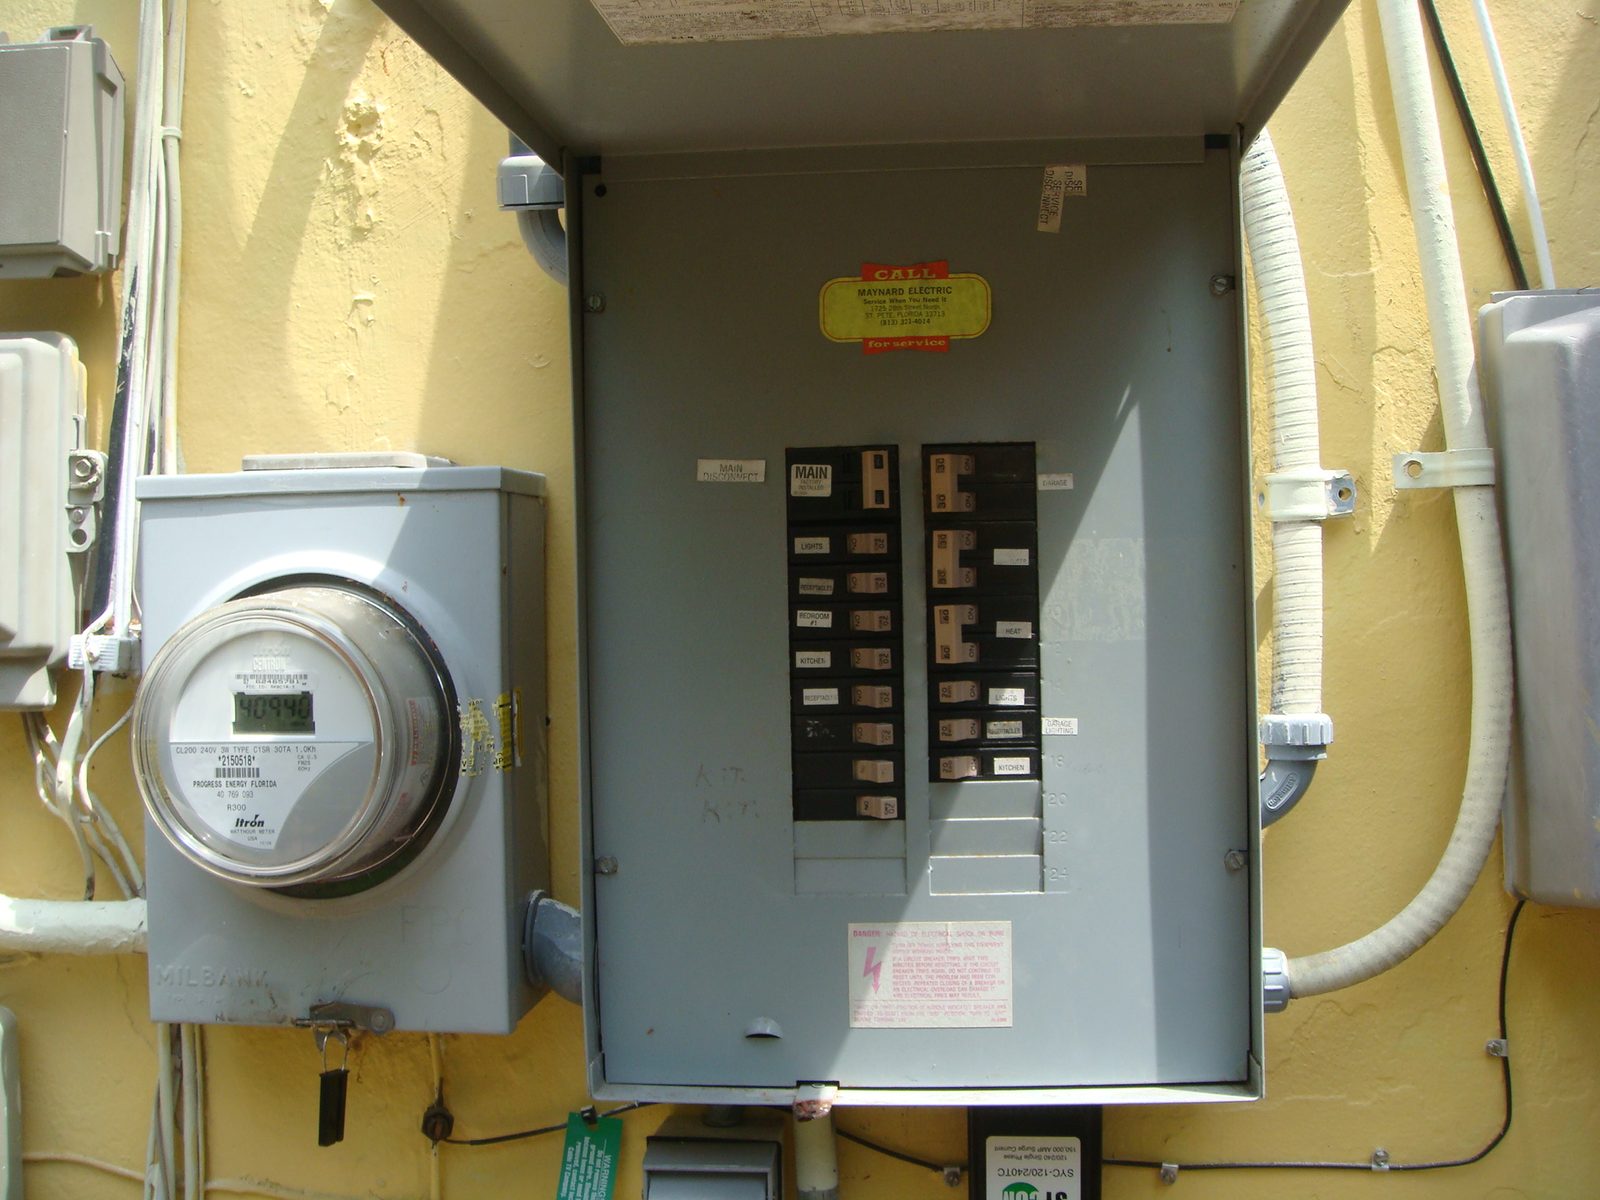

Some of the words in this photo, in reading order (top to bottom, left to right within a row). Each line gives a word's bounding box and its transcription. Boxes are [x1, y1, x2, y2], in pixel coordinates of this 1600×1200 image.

[1040, 169, 1055, 225] DISCNNECT
[874, 268, 937, 280] CALL
[858, 288, 905, 297] MAYNARD
[909, 286, 953, 295] ELECTRIC
[868, 340, 891, 348] for
[892, 338, 946, 347] service
[719, 464, 743, 472] MAIN
[795, 466, 828, 479] MAIN
[799, 612, 830, 620] BEDROOM
[1048, 830, 1068, 844] 22
[156, 964, 268, 988] MILBANK
[997, 1168, 1074, 1178] SYC-120/240TC
